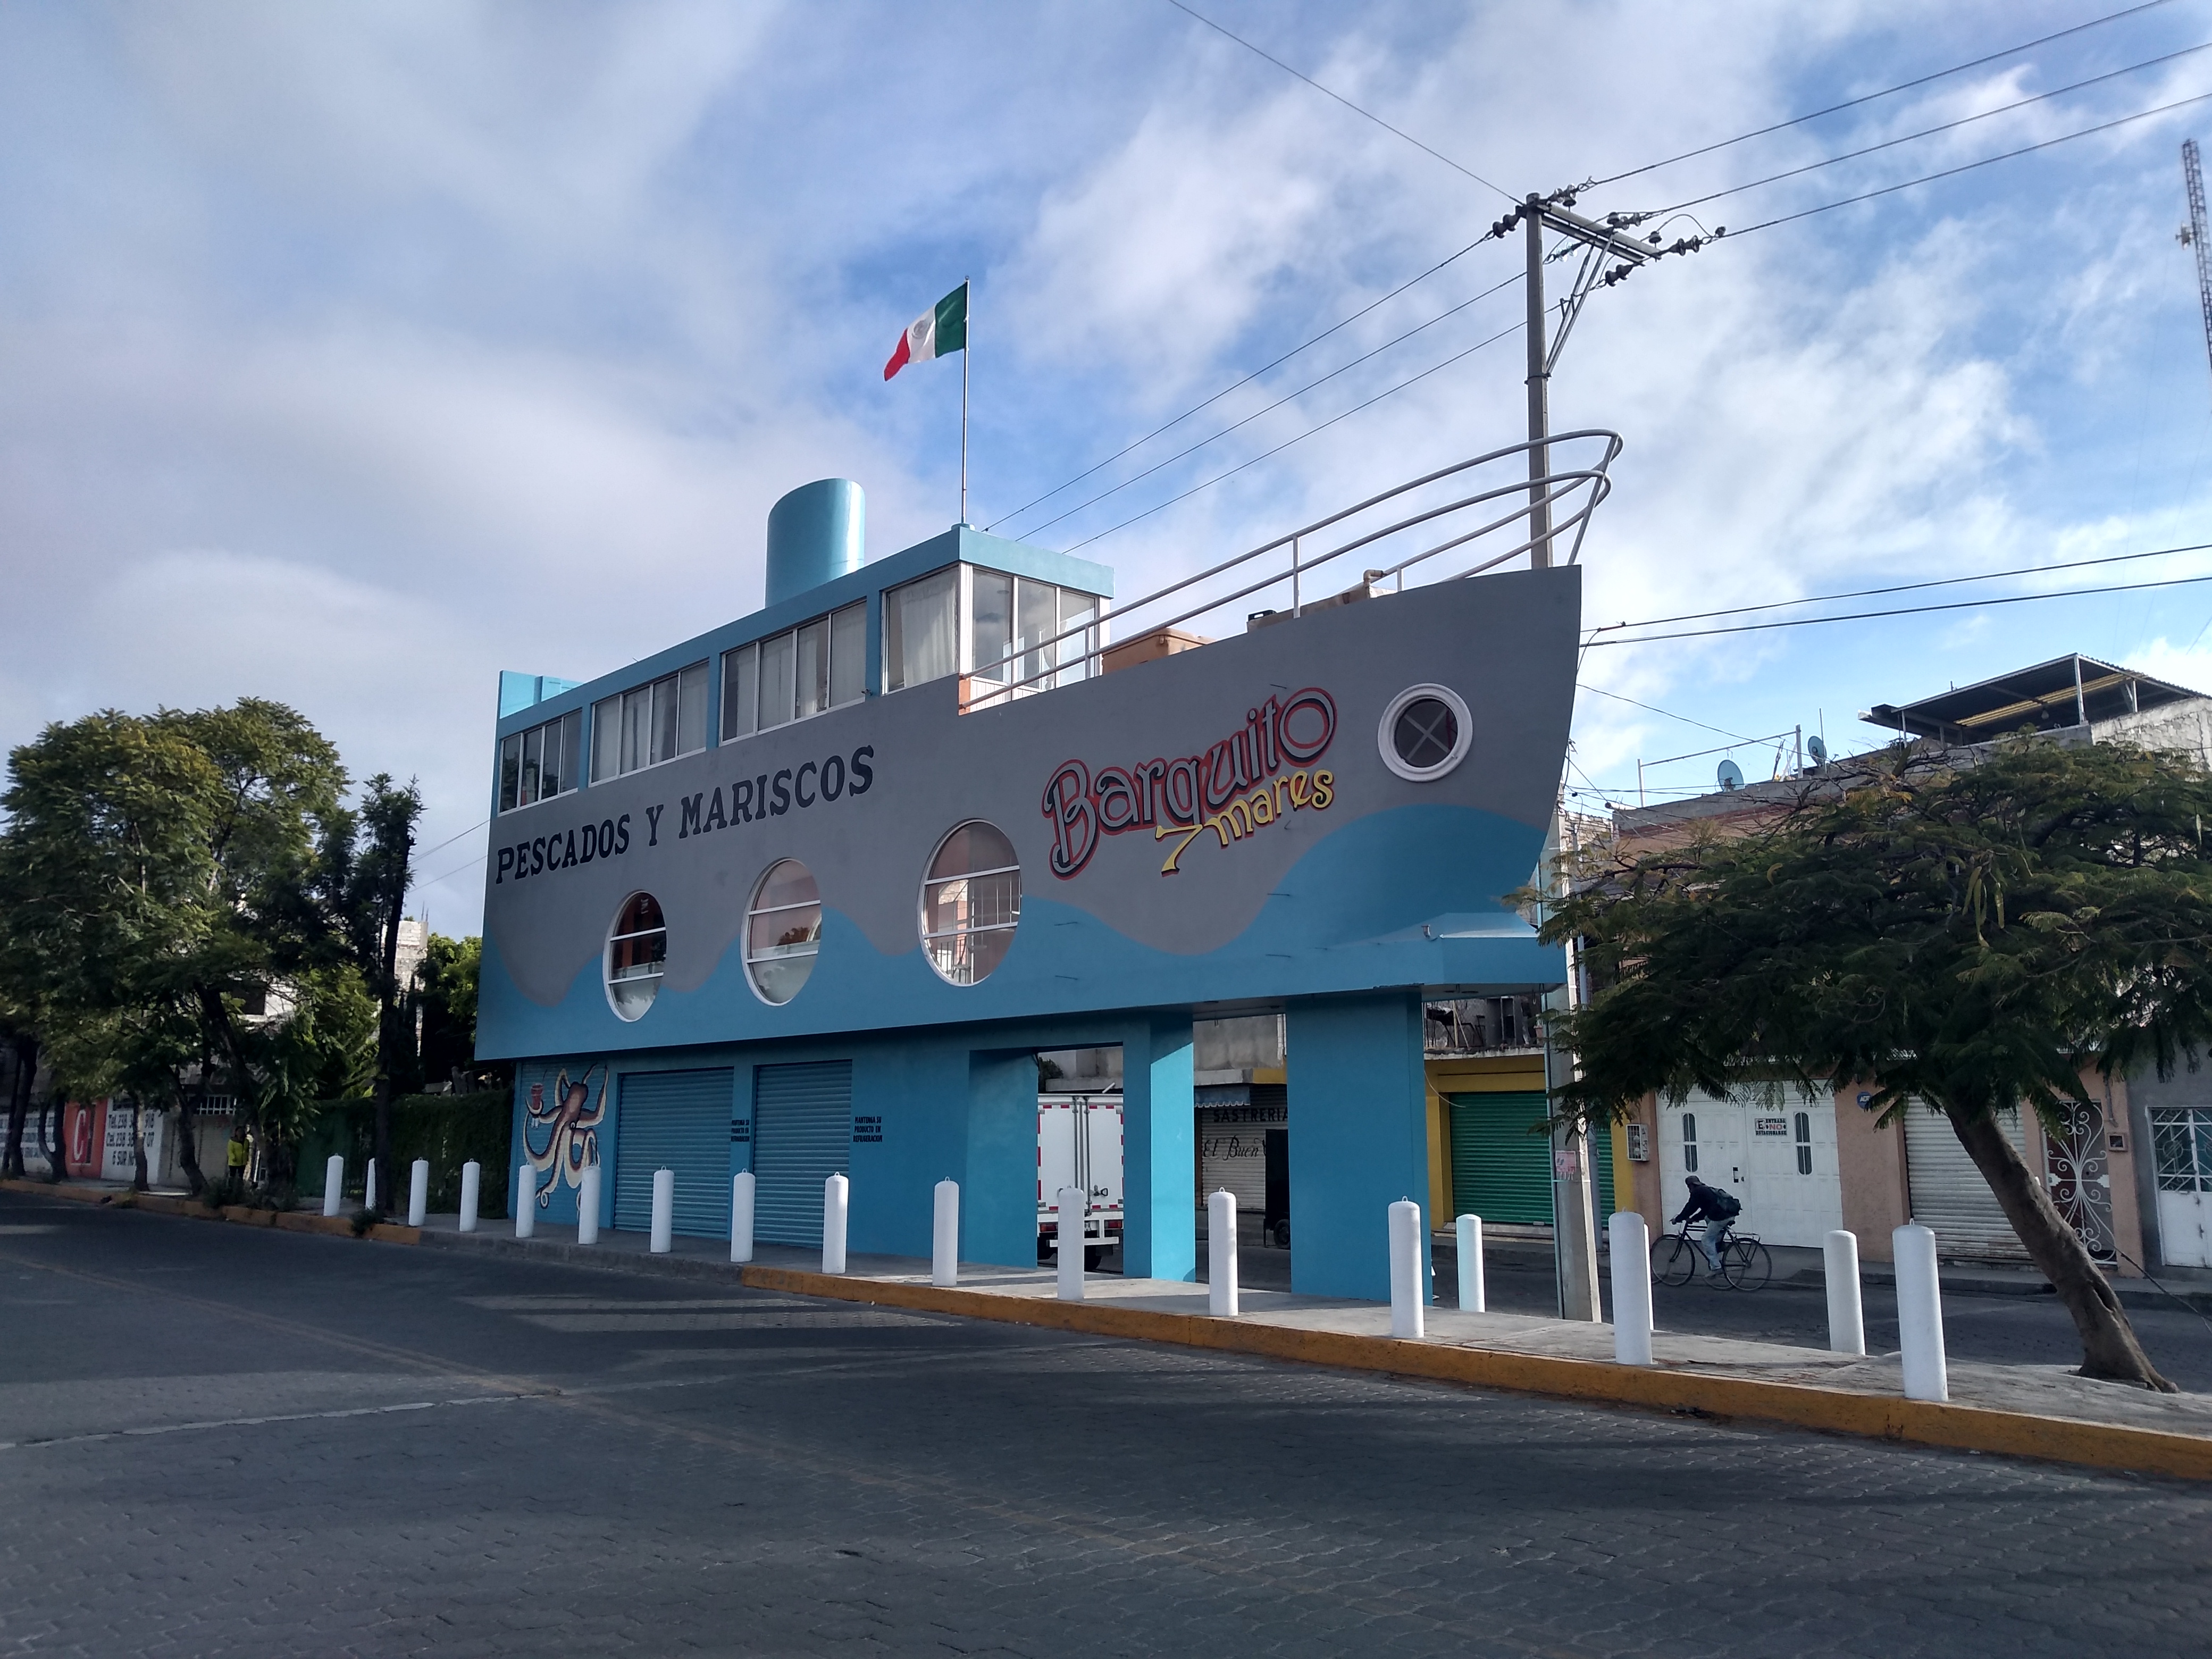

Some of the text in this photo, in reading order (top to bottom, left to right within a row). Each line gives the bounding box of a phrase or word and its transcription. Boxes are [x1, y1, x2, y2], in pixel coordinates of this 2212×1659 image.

[496, 745, 875, 884] PESCADOS Y MARISCOS
[1041, 687, 1337, 881] Barquito
[1155, 769, 1335, 877] 7 mares
[1203, 1137, 1218, 1158] El
[1222, 1135, 1259, 1161] Buen
[1213, 1108, 1288, 1122] SASTRERIA
